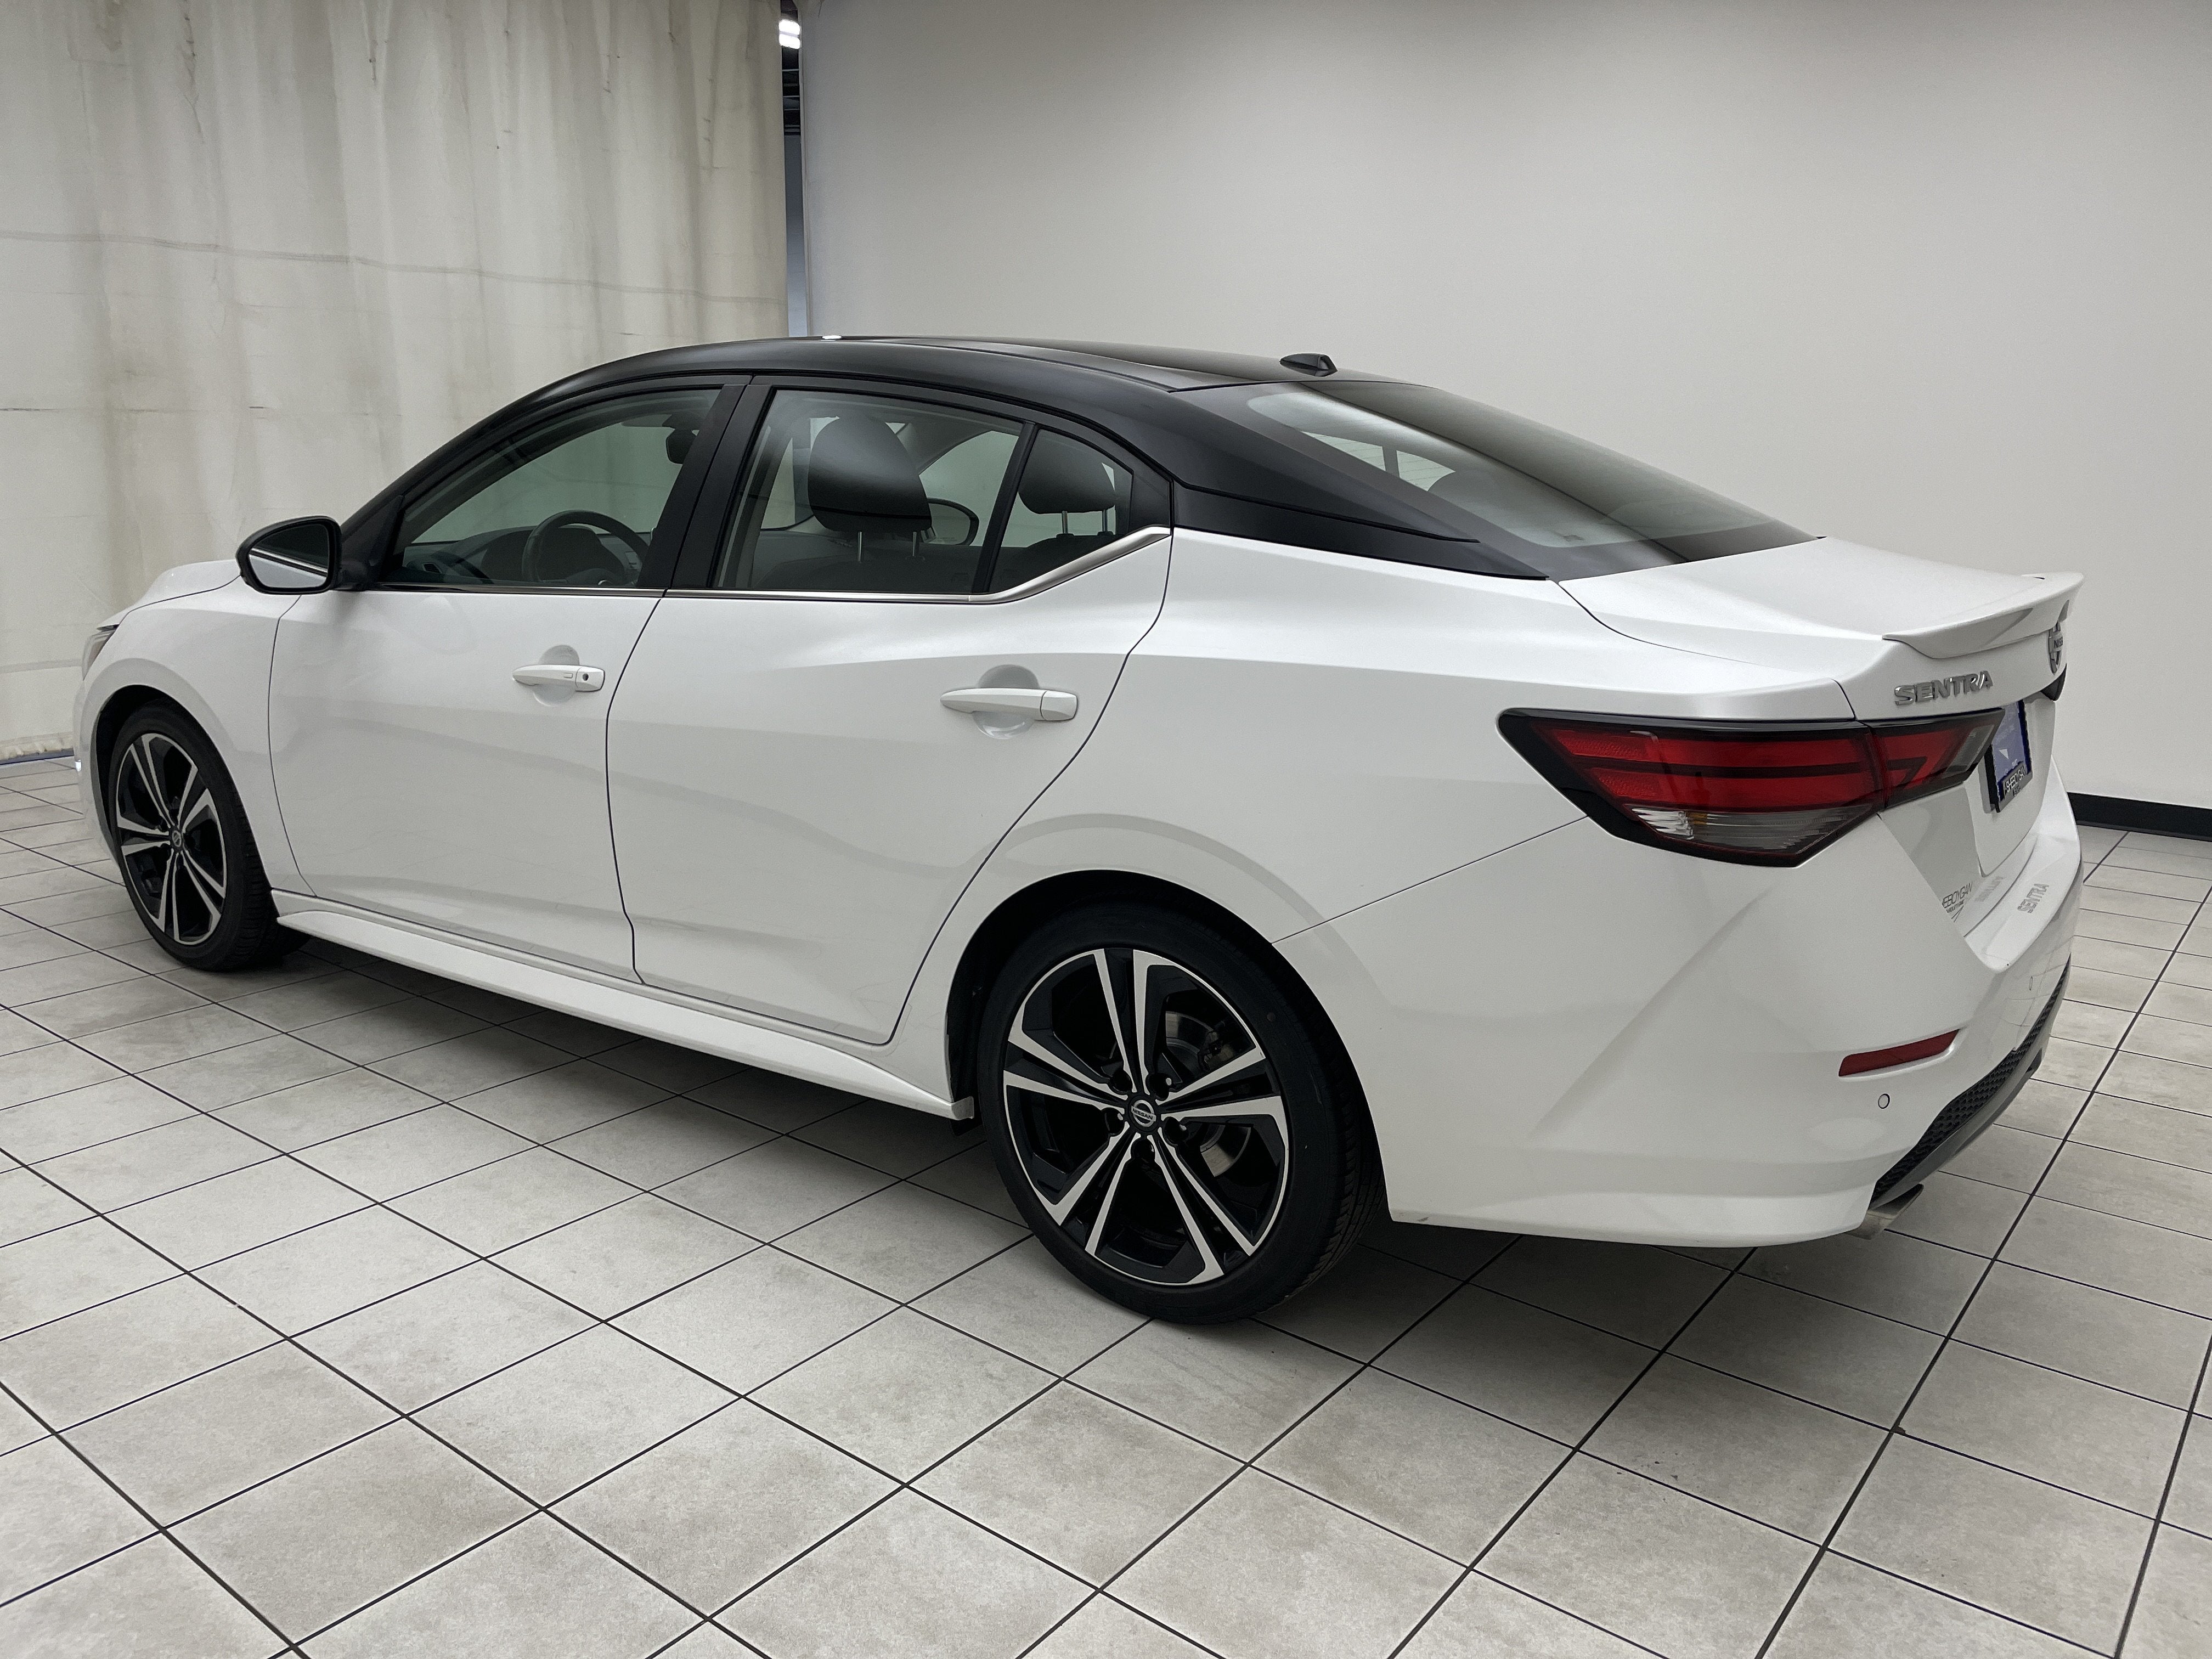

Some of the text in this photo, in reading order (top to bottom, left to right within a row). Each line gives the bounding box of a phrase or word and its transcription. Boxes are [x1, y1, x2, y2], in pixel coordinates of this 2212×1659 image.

[1894, 670, 1993, 706] SENTRA
[1942, 881, 1973, 909] EBOYGAN
[2017, 883, 2049, 913] SENTRA
[1132, 1108, 1153, 1120] NISSAN
